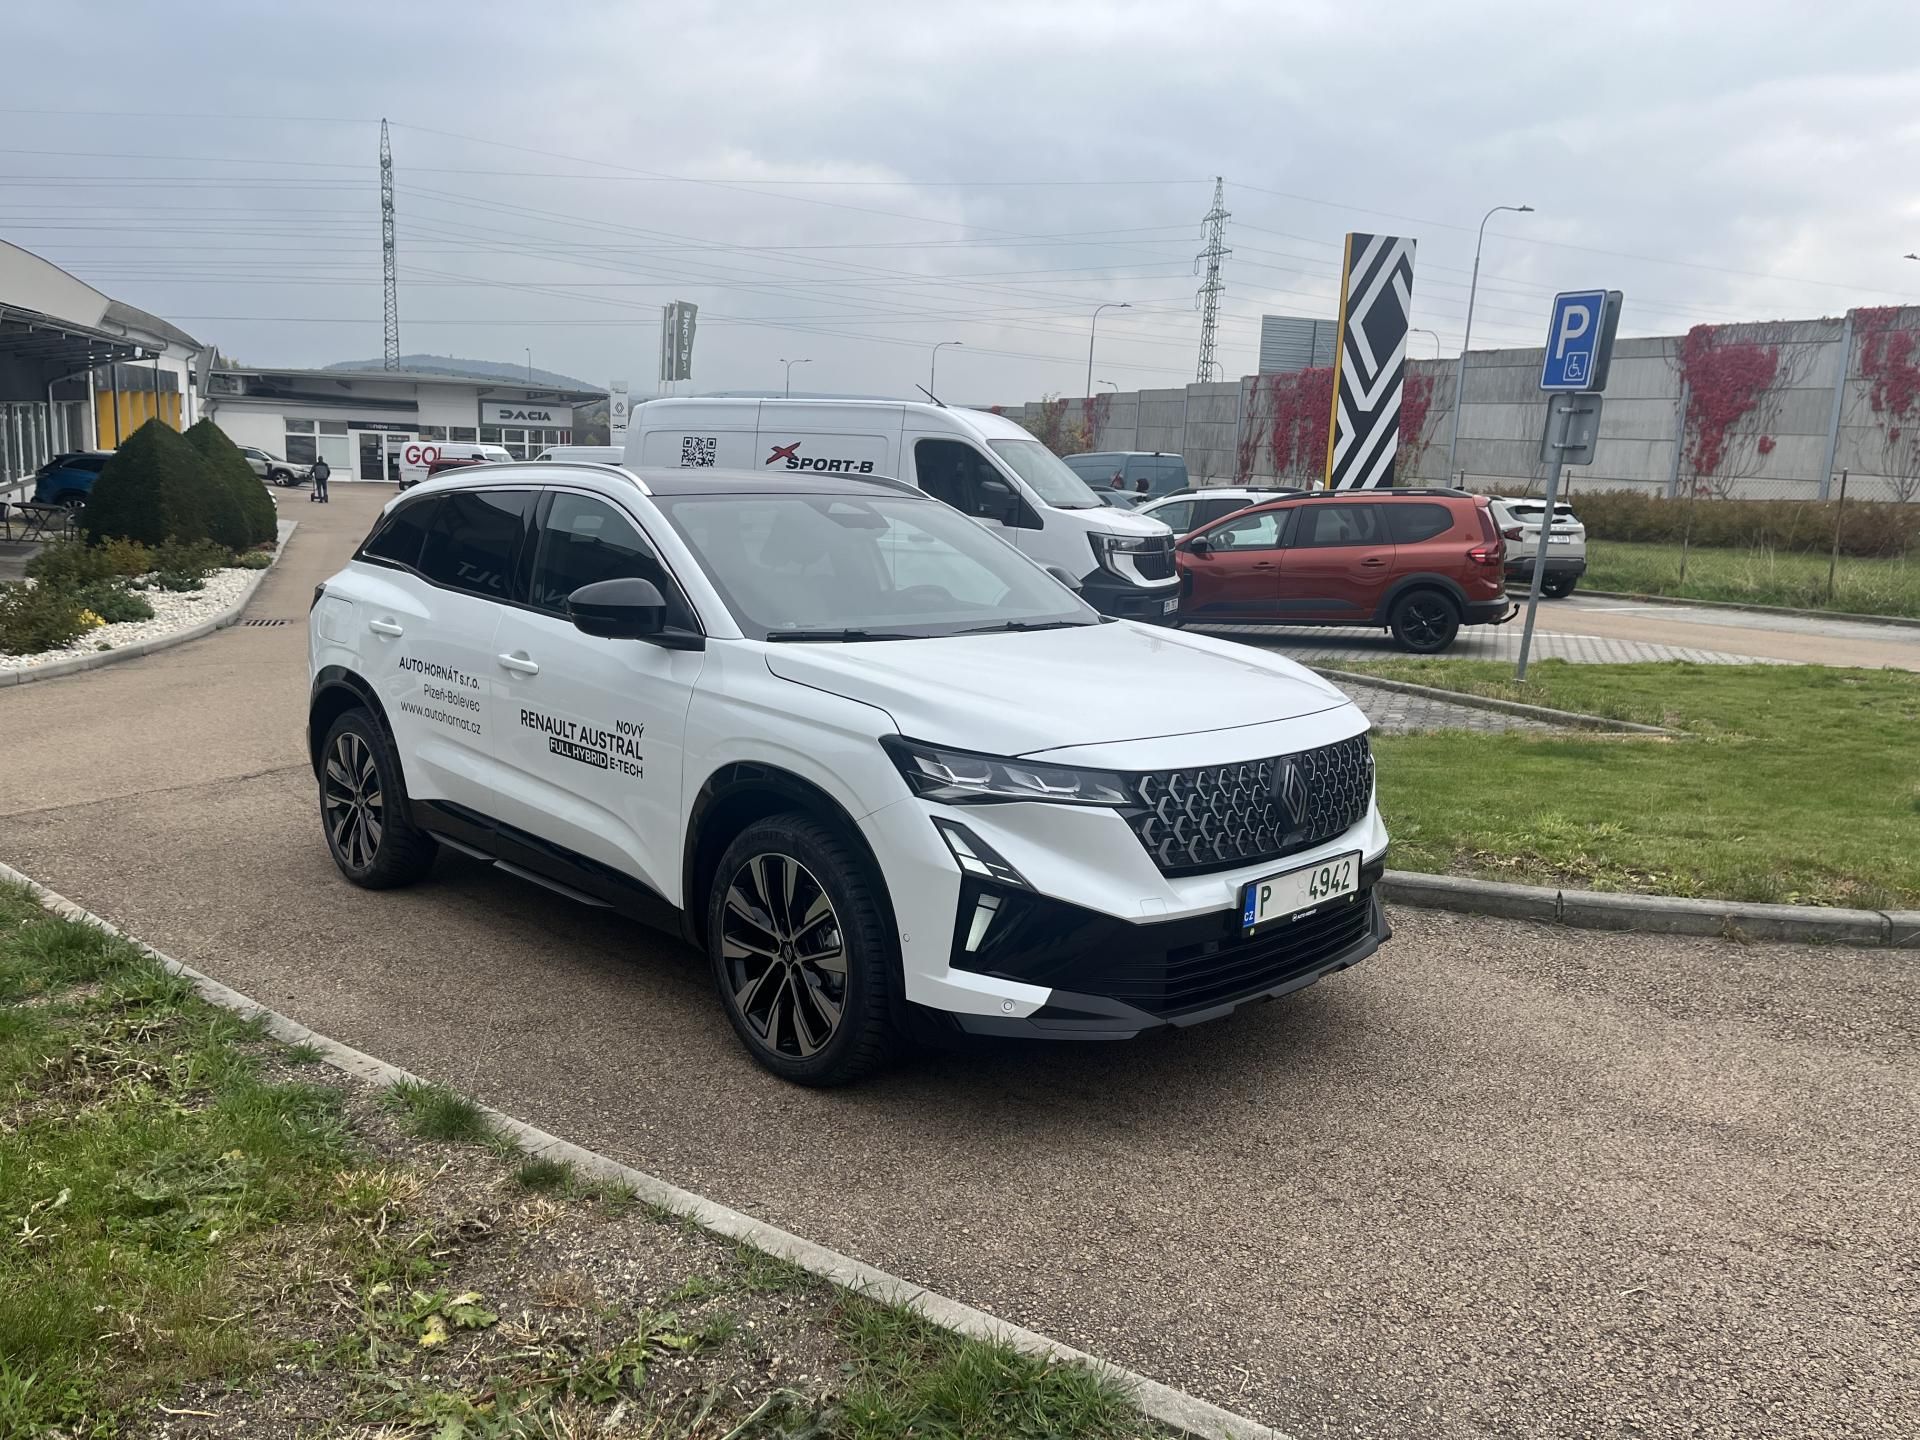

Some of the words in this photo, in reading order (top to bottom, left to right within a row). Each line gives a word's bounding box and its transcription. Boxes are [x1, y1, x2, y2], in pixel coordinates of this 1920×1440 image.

[681, 310, 691, 371] WELCOME
[1556, 305, 1590, 360] P
[499, 410, 552, 421] DACIA
[786, 458, 874, 473] SPORT-B
[399, 656, 424, 673] AUTO
[424, 665, 459, 684] HORNÁT
[424, 683, 480, 712] Plzeň-Bolevec
[400, 701, 481, 735] www.autohornat.cz
[616, 719, 645, 739] NOVÝ
[520, 708, 577, 740] RENAULT
[579, 726, 643, 760] AUSTRAL
[549, 740, 573, 757] FULL
[572, 744, 607, 768] HYBRID
[609, 757, 644, 779] E-TECH
[1260, 886, 1272, 917] P
[1309, 860, 1351, 900] 4942
[1243, 910, 1254, 922] CZ
